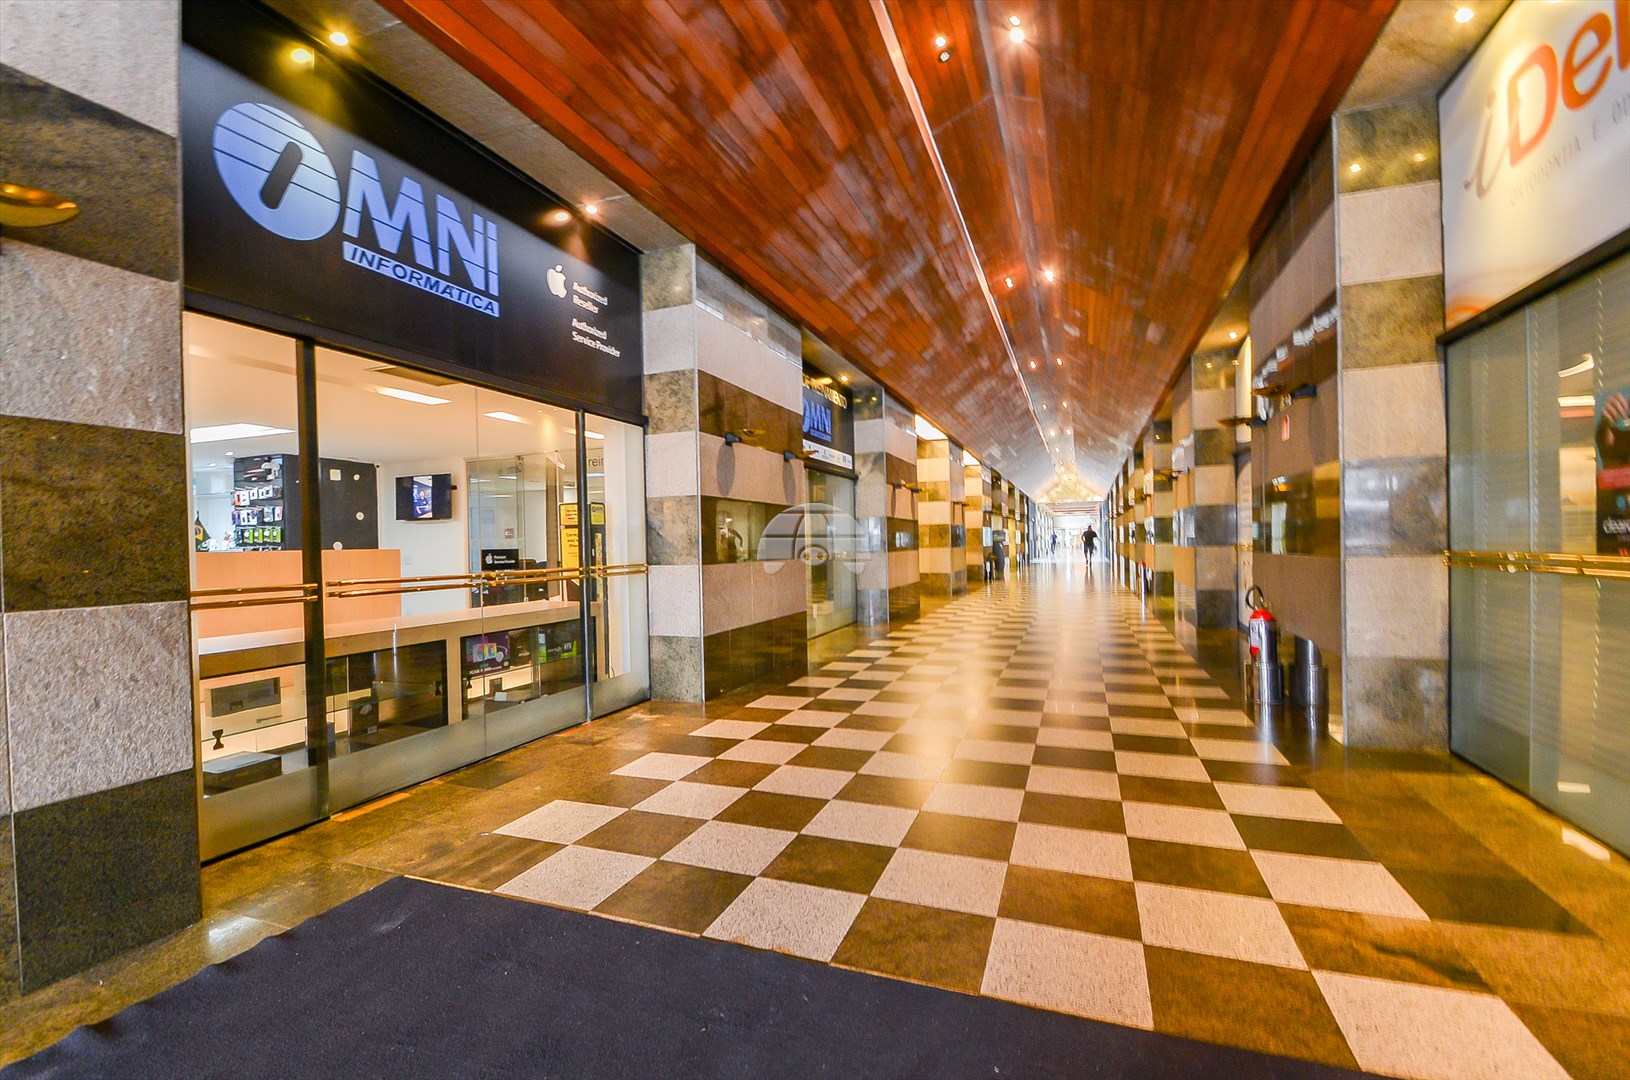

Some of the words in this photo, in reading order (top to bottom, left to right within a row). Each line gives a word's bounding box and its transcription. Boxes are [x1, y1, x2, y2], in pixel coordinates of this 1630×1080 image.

[212, 102, 499, 297] OMNI
[572, 281, 608, 306] Authorized
[572, 294, 599, 314] Reseller
[571, 317, 608, 340] Authorized
[571, 331, 596, 349] Service
[595, 340, 621, 358] Provider
